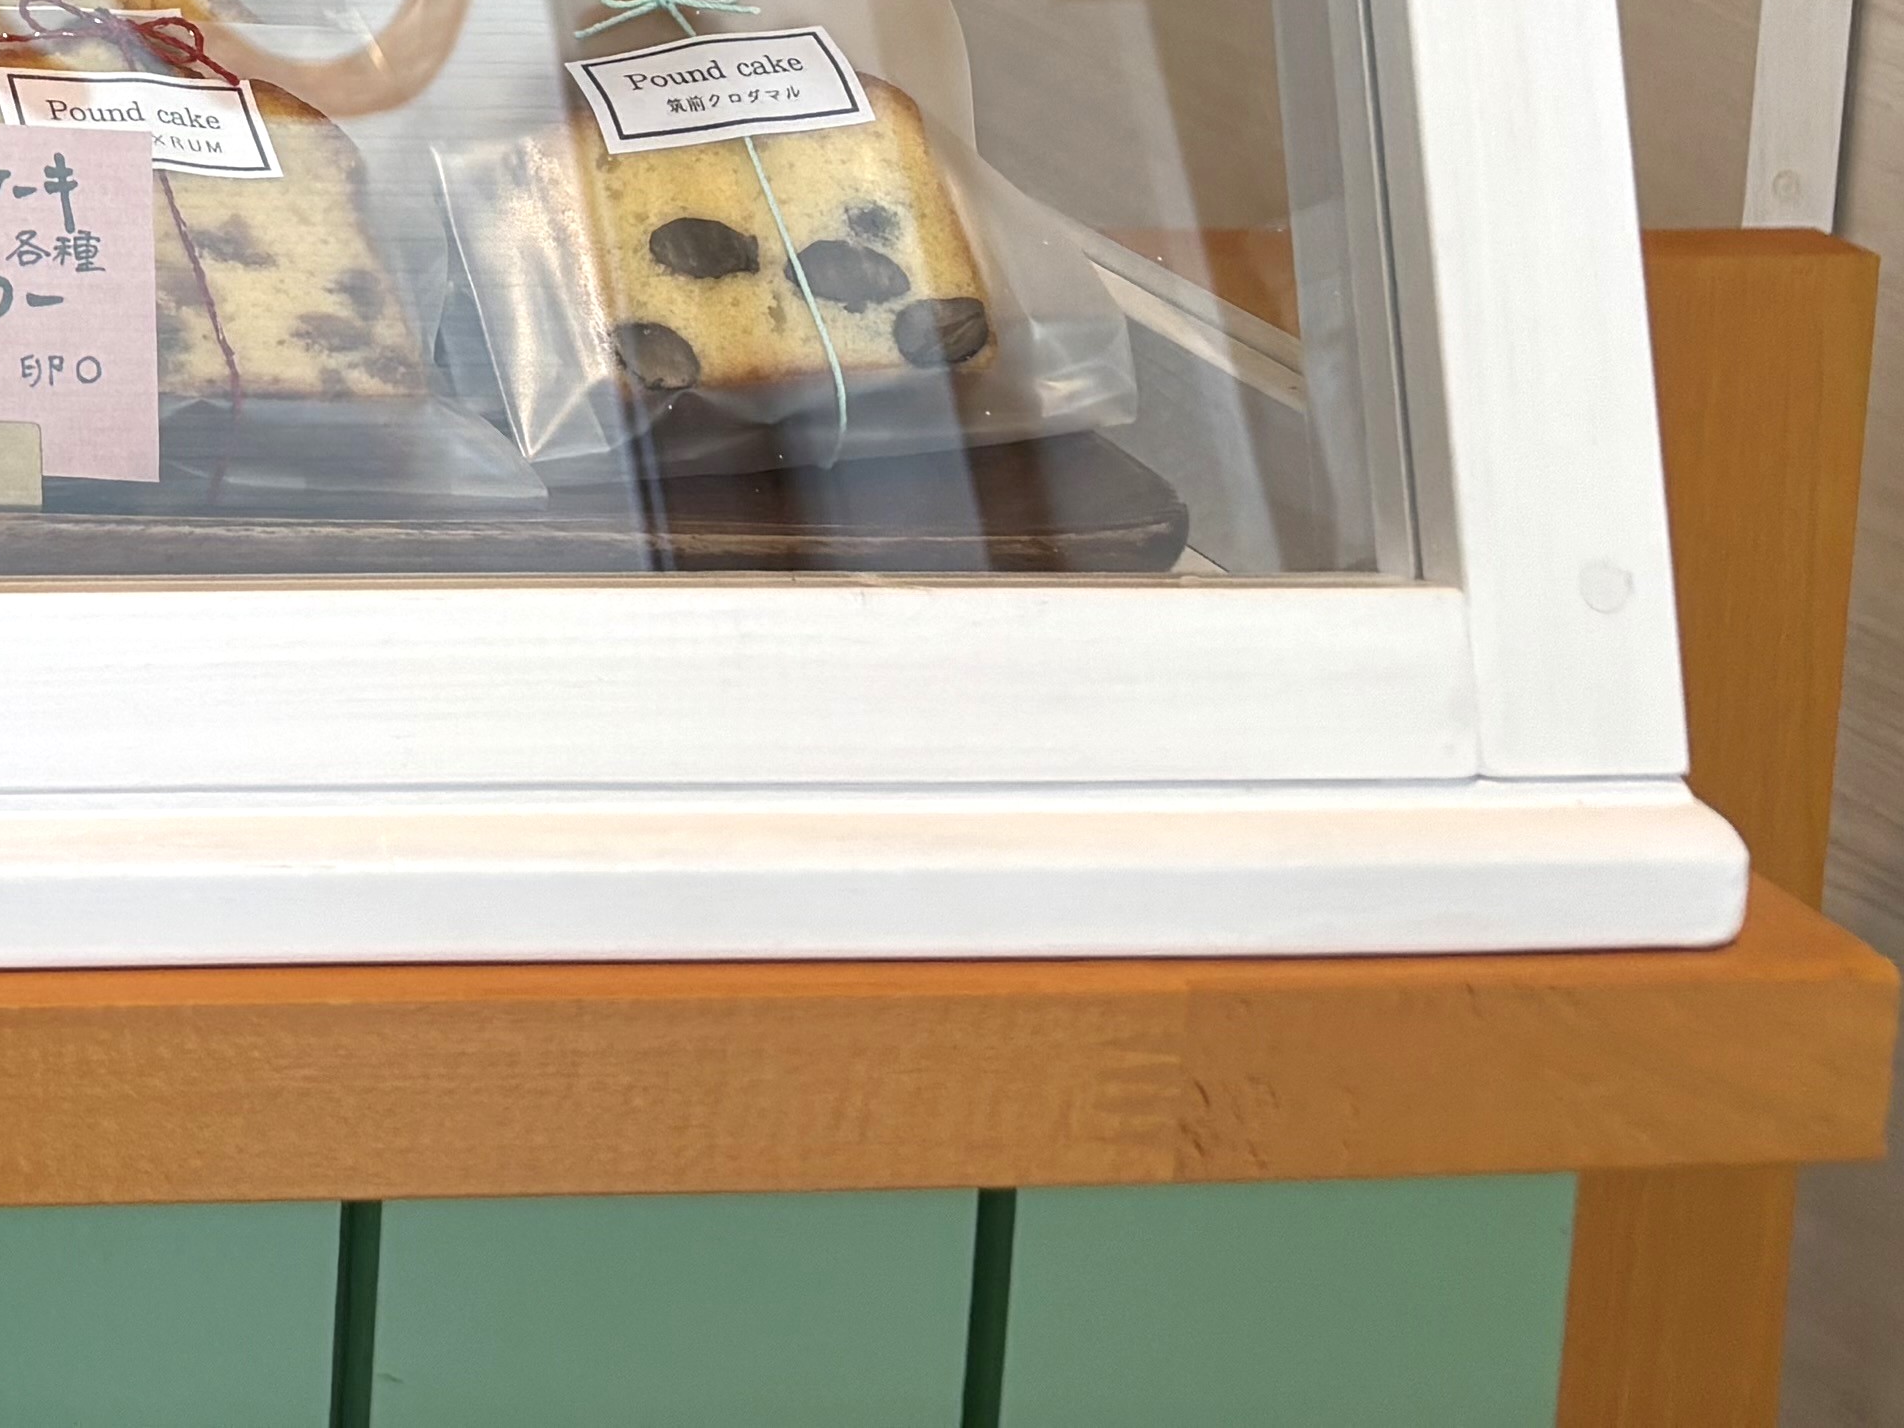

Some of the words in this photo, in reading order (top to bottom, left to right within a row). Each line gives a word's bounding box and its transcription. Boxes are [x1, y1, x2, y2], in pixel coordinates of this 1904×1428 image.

[622, 58, 728, 92] Pound
[735, 54, 805, 79] cake
[44, 98, 147, 123] Pound
[156, 106, 223, 131] cake
[665, 84, 801, 115] 筑前クロダマル
[4, 228, 106, 275] 各種
